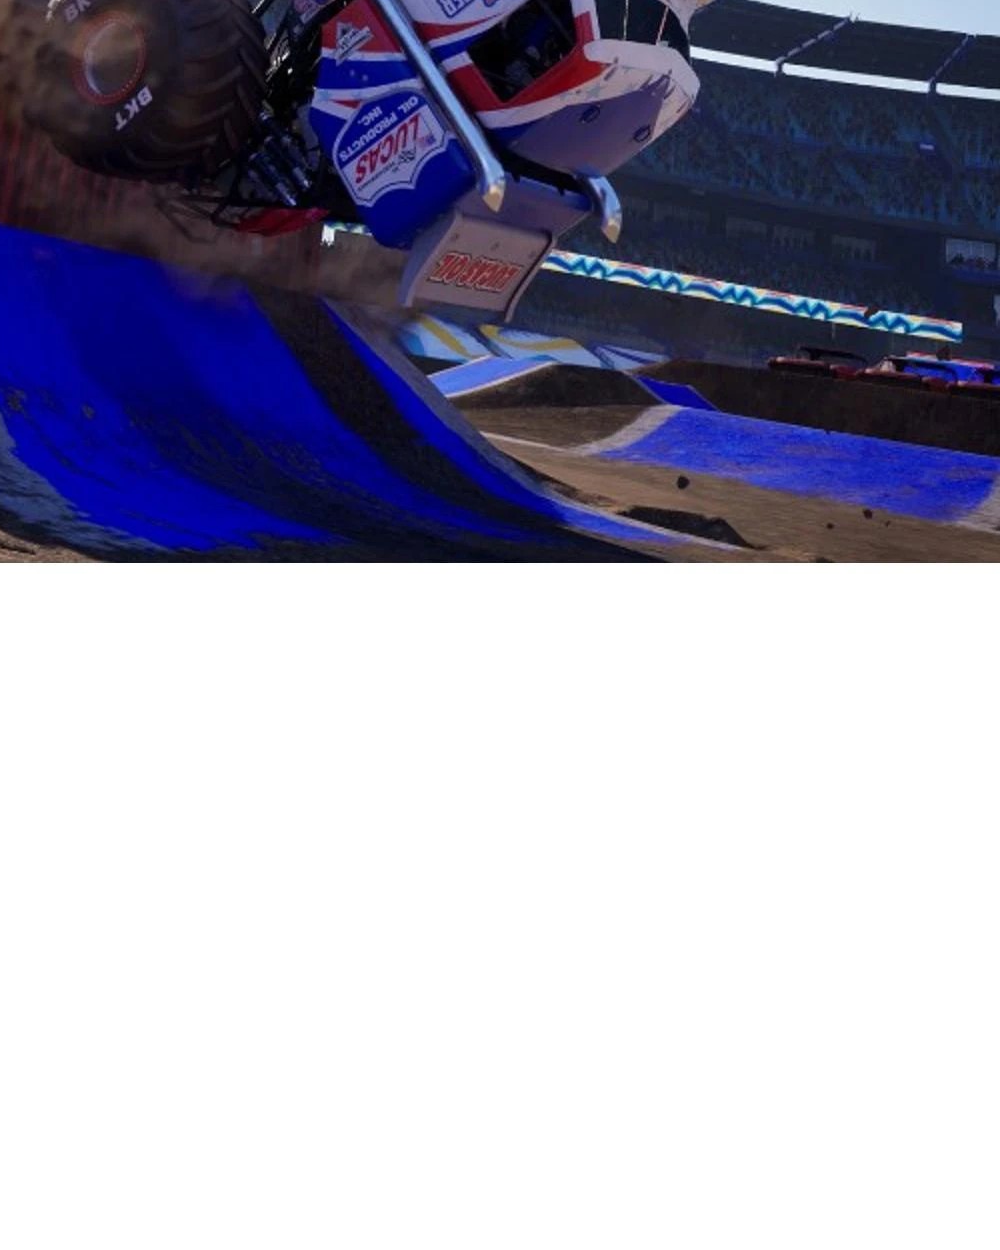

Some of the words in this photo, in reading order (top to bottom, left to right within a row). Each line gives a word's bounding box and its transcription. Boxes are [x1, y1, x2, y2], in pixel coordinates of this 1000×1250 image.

[115, 86, 153, 131] BKT
[357, 106, 383, 127] INC.
[397, 95, 419, 114] OIL
[340, 111, 398, 162] PRODUCTS
[355, 113, 421, 185] LUCAS
[428, 252, 471, 286] OIL
[457, 256, 522, 293] LUCAS
